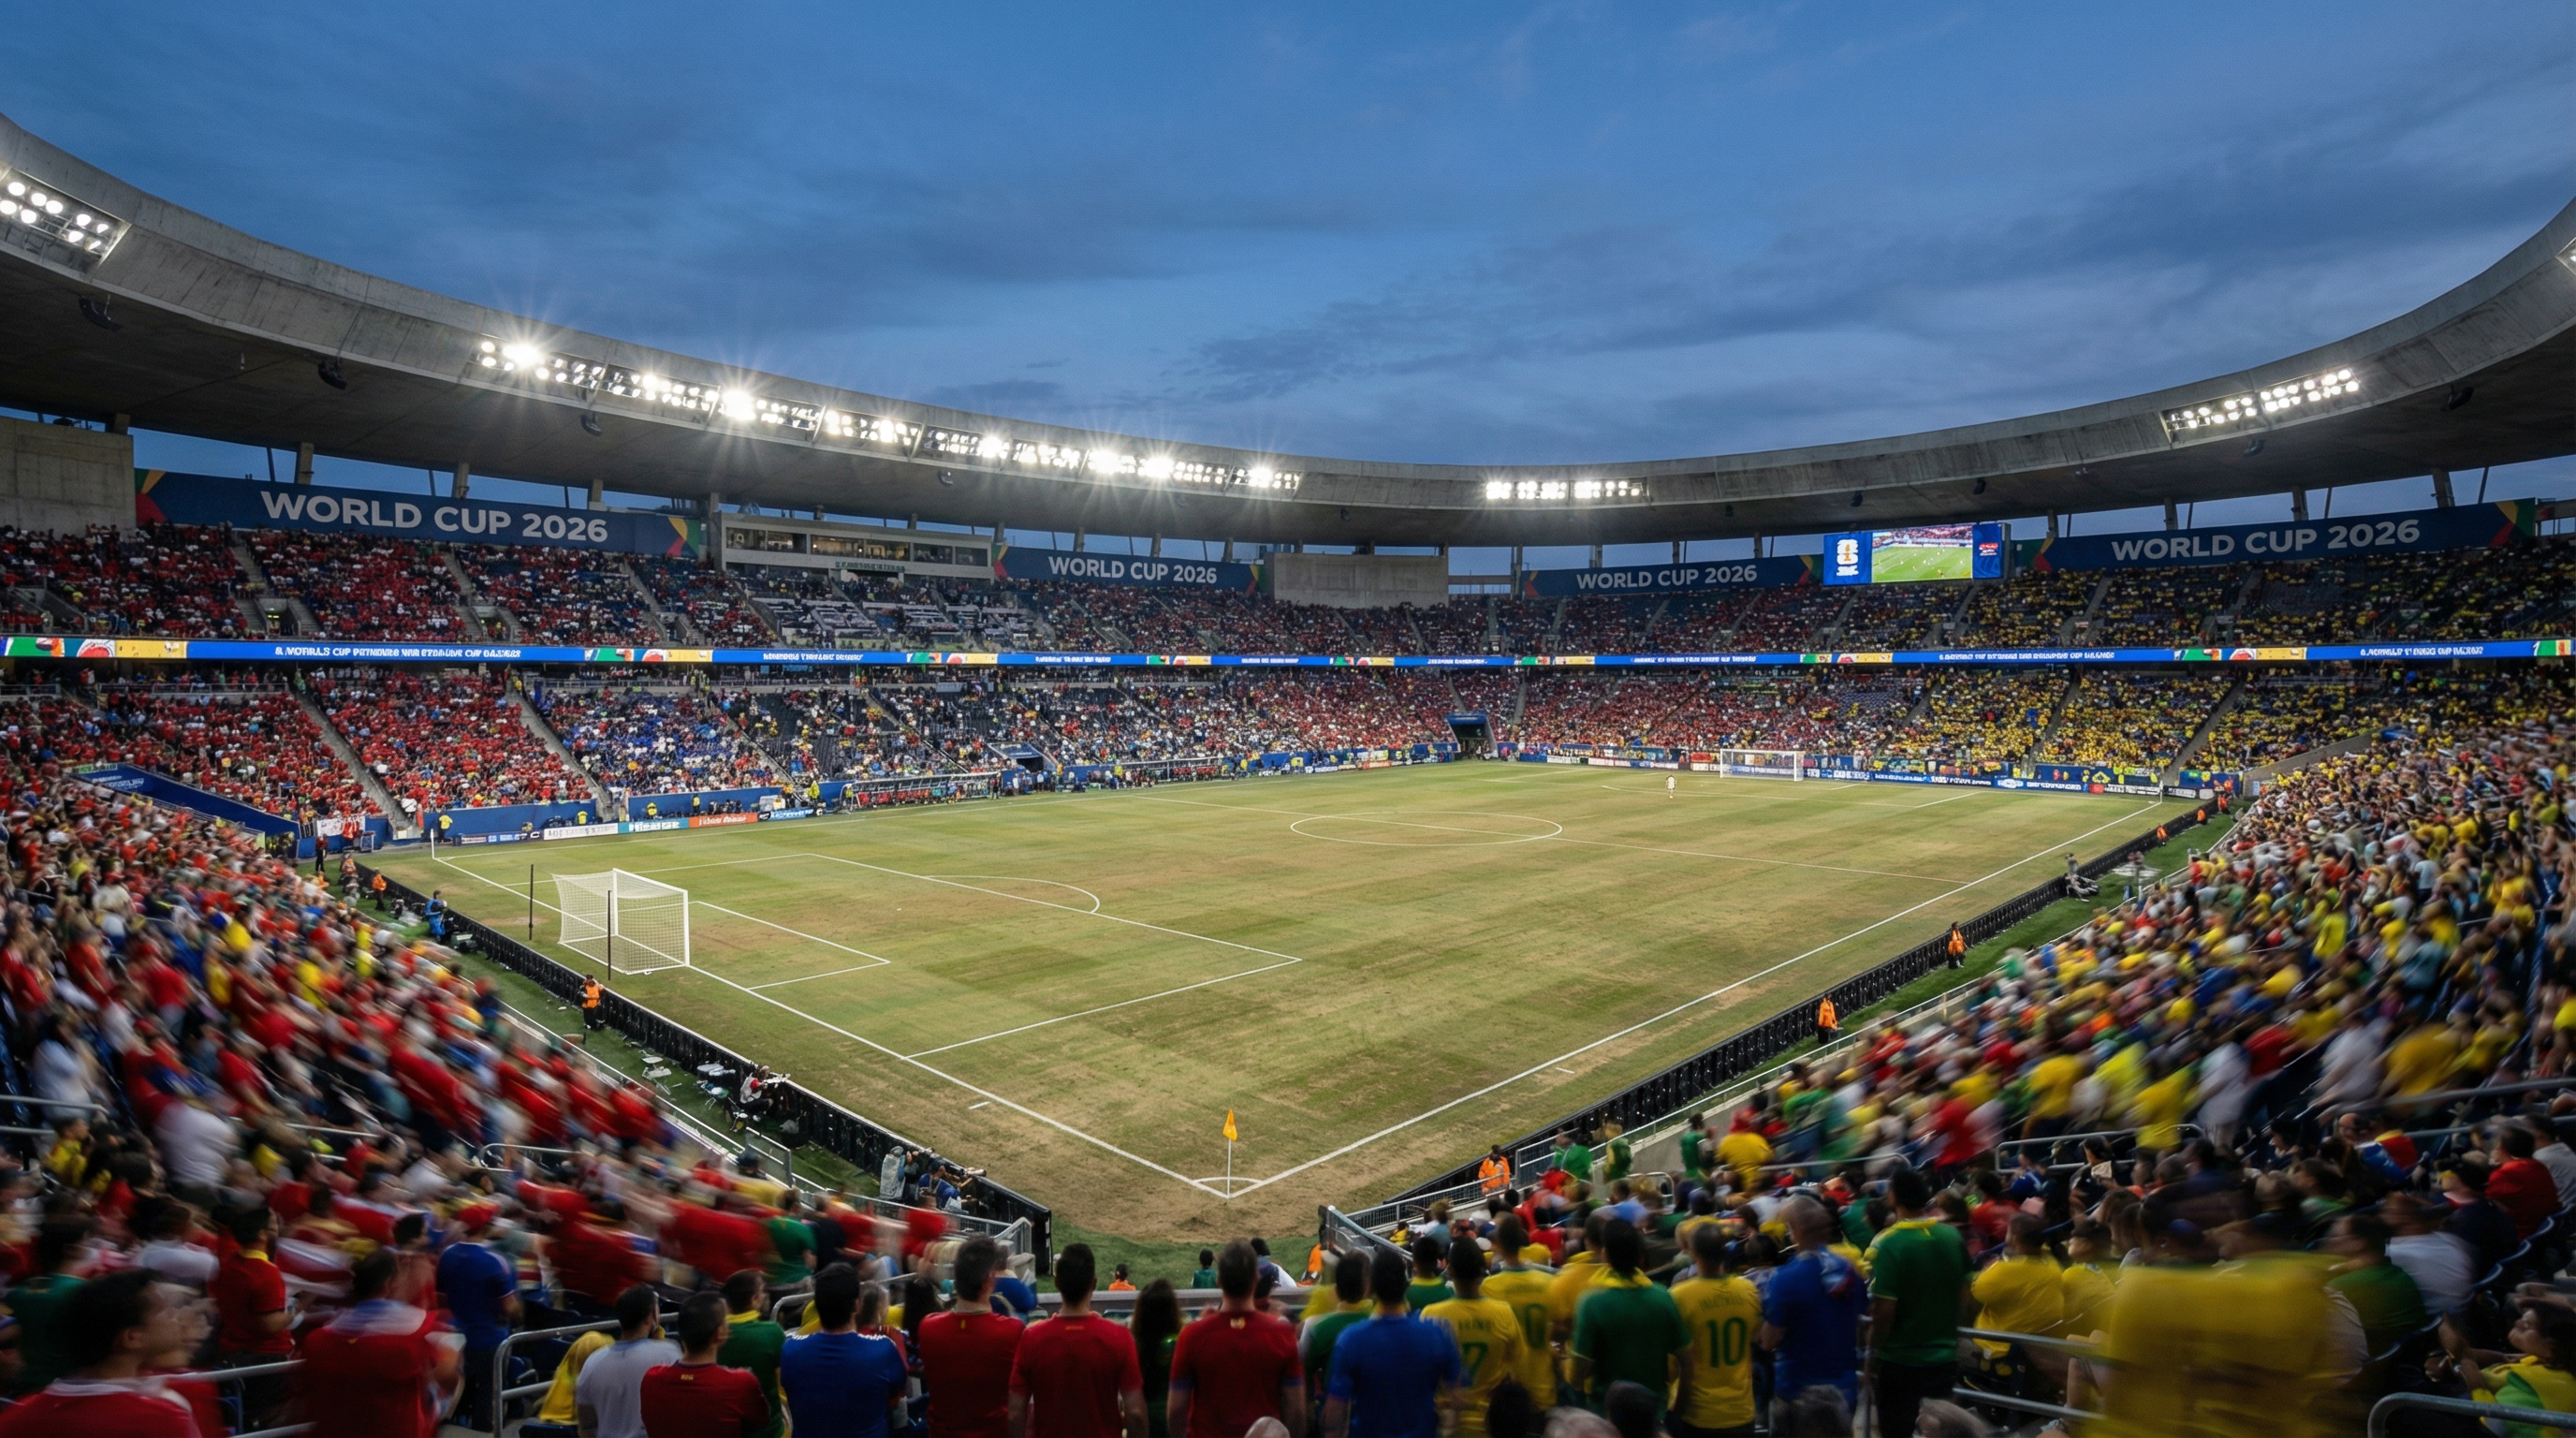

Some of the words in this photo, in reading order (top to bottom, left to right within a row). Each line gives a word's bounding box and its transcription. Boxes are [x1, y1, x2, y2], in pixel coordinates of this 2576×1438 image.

[260, 491, 422, 528] WORLD
[434, 506, 511, 535] CUP
[522, 513, 608, 543] 2026
[2111, 535, 2235, 561] WORLD
[2245, 528, 2318, 554] CUP
[2327, 519, 2421, 550] 2026
[1048, 556, 1124, 579] WORLD
[1130, 562, 1169, 580] CUP
[1173, 565, 1218, 584] 2026
[1576, 571, 1653, 590] WORLD
[1658, 568, 1699, 586] CUP
[1705, 565, 1758, 584] 2026
[1462, 1342, 1488, 1384] 7
[1706, 1316, 1747, 1368] 10
